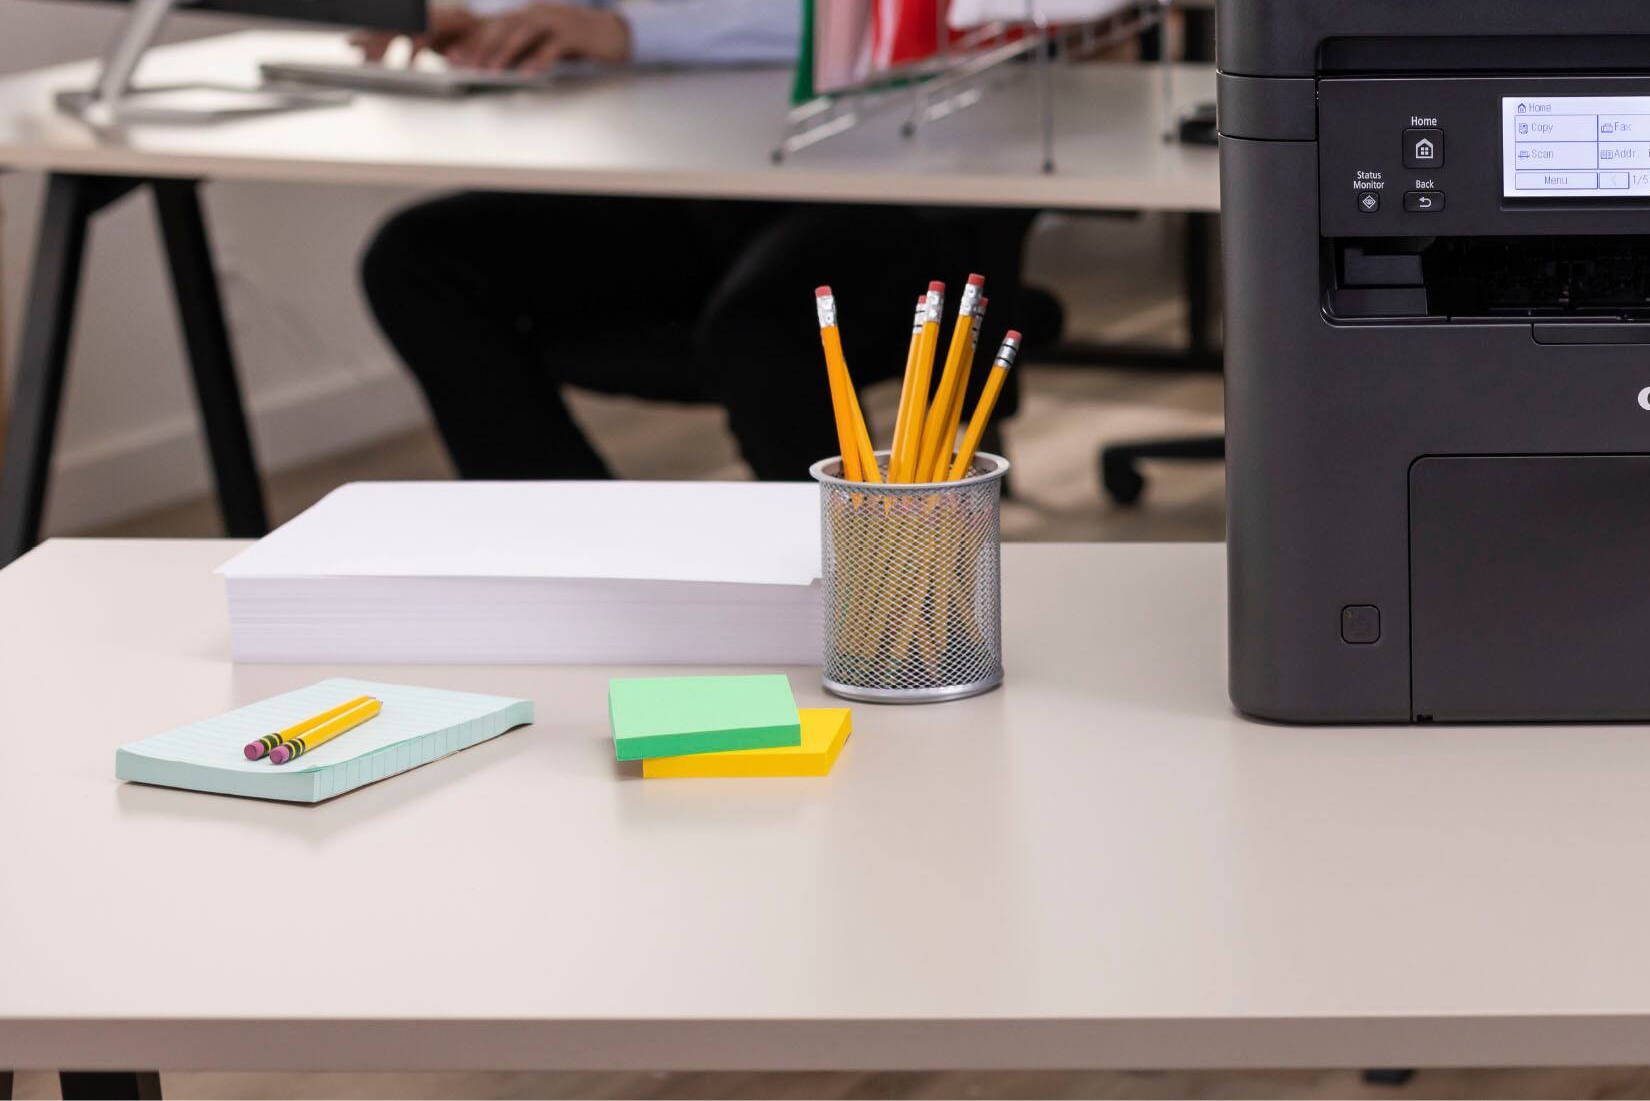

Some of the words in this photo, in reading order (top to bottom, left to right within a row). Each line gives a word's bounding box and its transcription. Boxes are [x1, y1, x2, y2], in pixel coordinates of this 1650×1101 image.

[1529, 103, 1551, 112] Home
[1411, 116, 1437, 126] Home
[1532, 123, 1553, 133] Copy
[1614, 123, 1631, 131] Fax
[1532, 150, 1554, 158] Scan
[1357, 171, 1381, 179] Status
[1632, 175, 1649, 184] 1/5
[1354, 181, 1384, 189] Monitor
[1416, 180, 1434, 189] Back
[1544, 176, 1568, 185] Menu
